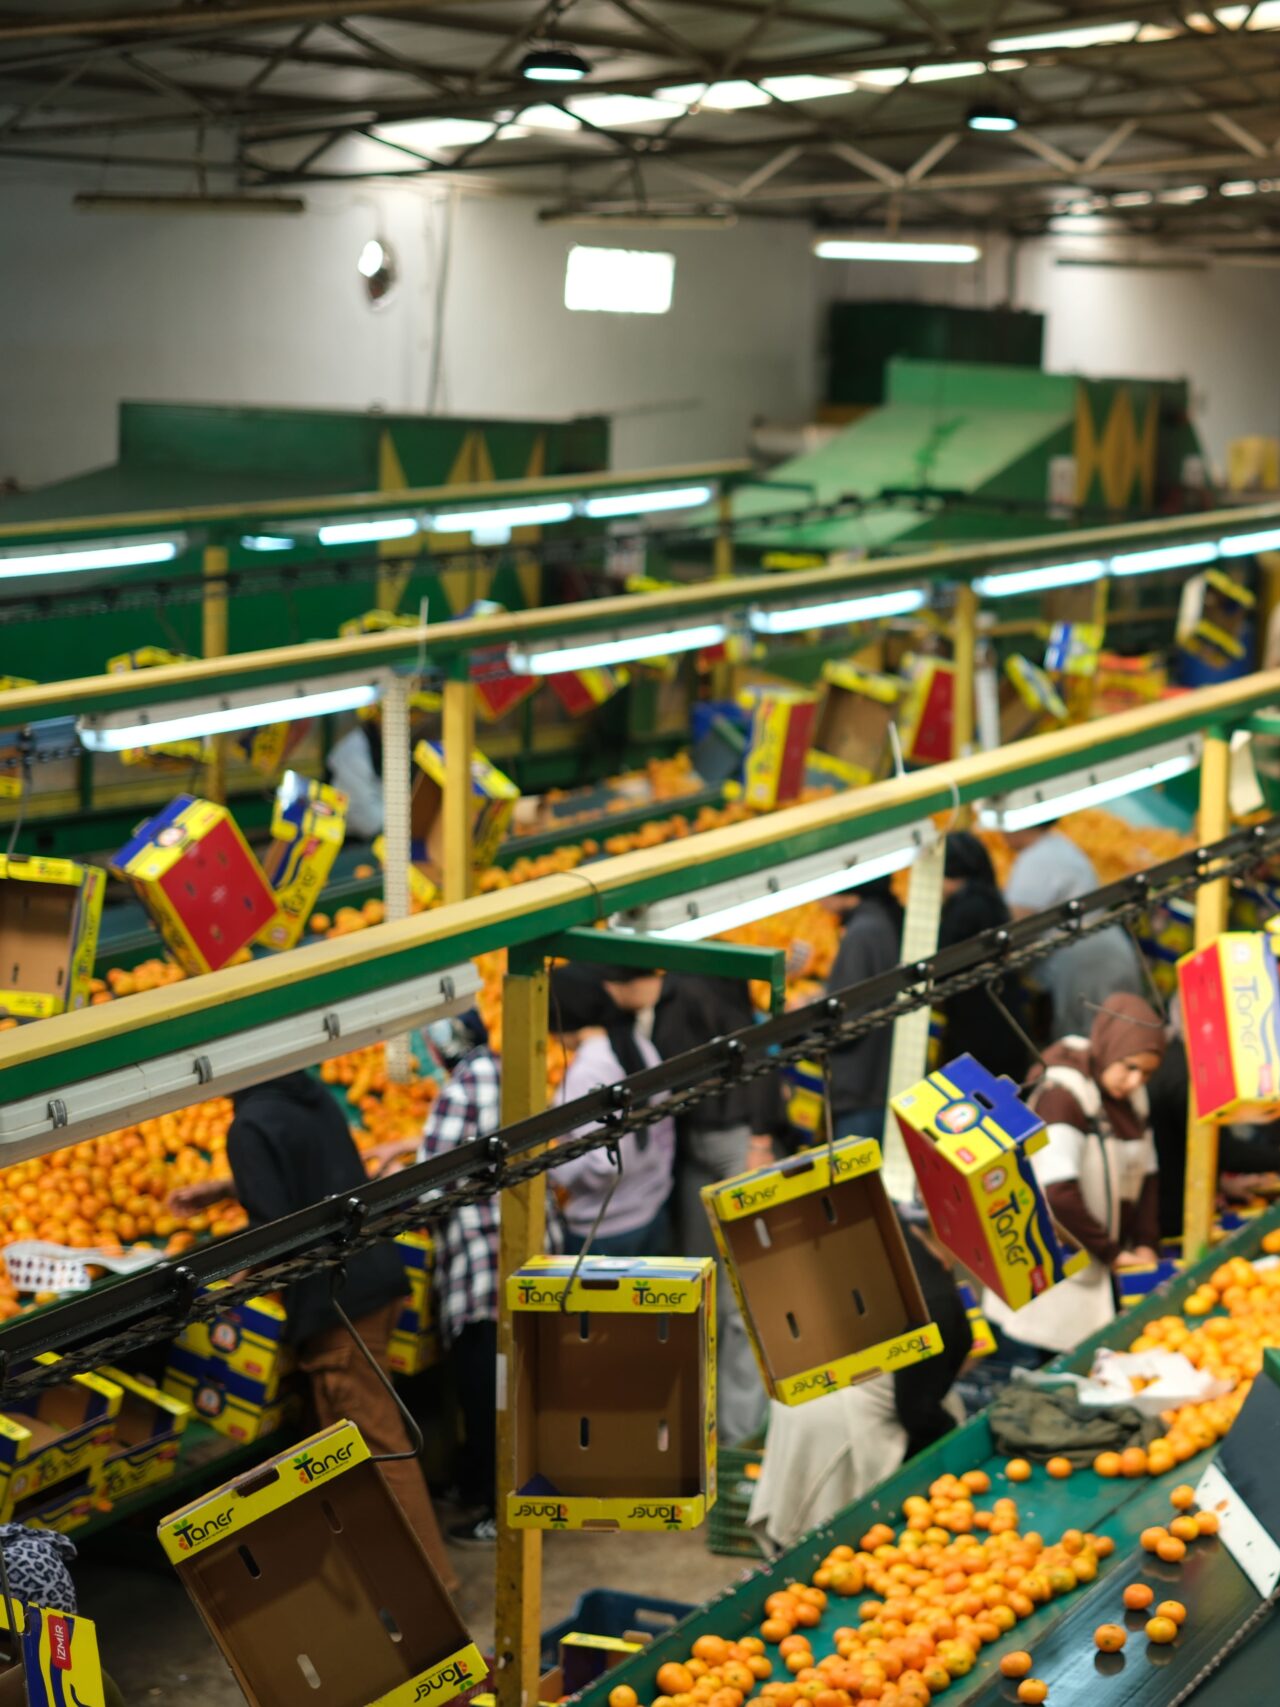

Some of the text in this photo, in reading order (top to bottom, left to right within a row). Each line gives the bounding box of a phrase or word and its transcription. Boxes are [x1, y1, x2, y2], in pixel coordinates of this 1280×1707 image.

[731, 1185, 778, 1209] Taner
[988, 1189, 1029, 1266] Taner
[632, 1287, 688, 1306] Taner
[886, 1335, 932, 1361] Taner
[791, 1369, 838, 1396] Taner
[293, 1441, 354, 1482] Taner
[514, 1503, 569, 1523] Taner
[627, 1503, 682, 1524] Taner
[173, 1507, 234, 1549] Taner
[413, 1661, 473, 1704] Taner
